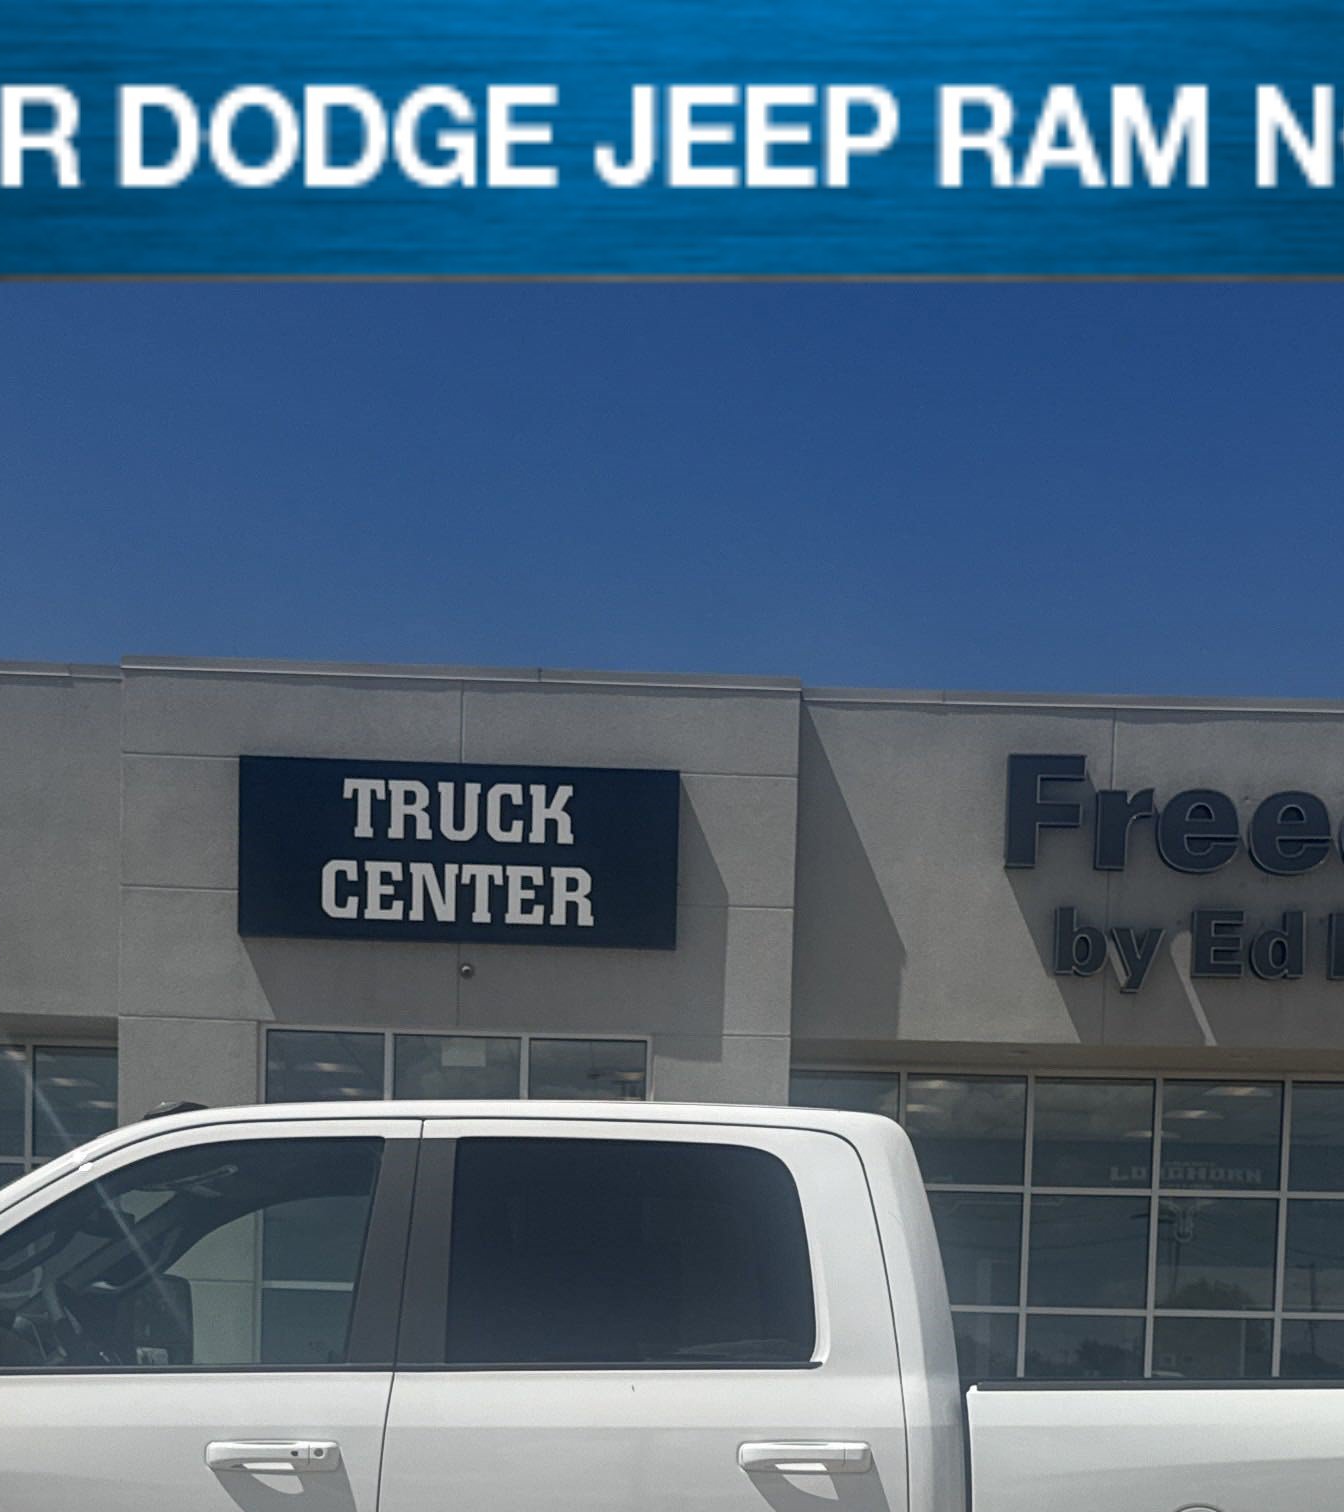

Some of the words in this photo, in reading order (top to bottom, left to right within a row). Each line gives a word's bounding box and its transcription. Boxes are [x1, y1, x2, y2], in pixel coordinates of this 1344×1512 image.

[342, 777, 575, 845] TRUCK
[320, 858, 595, 927] CENTER
[1055, 906, 1165, 993] by
[1190, 909, 1307, 979] Ed
